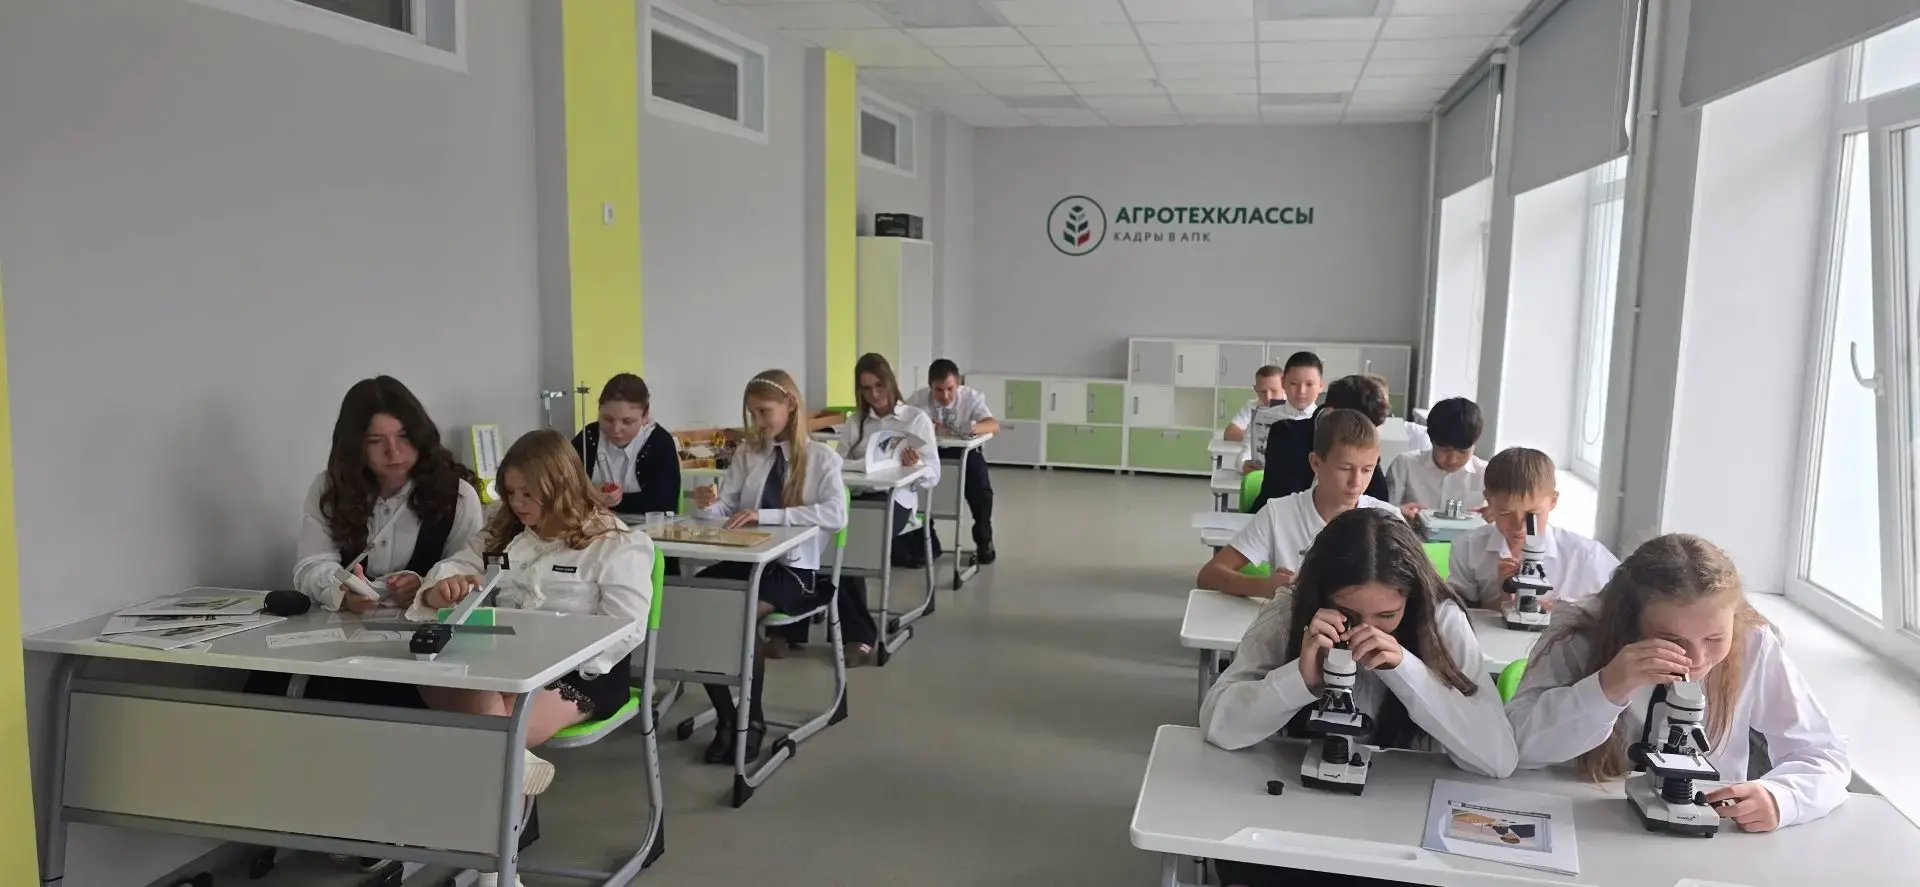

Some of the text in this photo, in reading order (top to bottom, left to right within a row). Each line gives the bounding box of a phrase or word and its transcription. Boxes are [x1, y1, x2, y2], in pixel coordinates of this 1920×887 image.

[1114, 206, 1315, 225] АГРОТЕХКЛАССЫ
[1113, 231, 1211, 243] КАДРЫ В АПК
